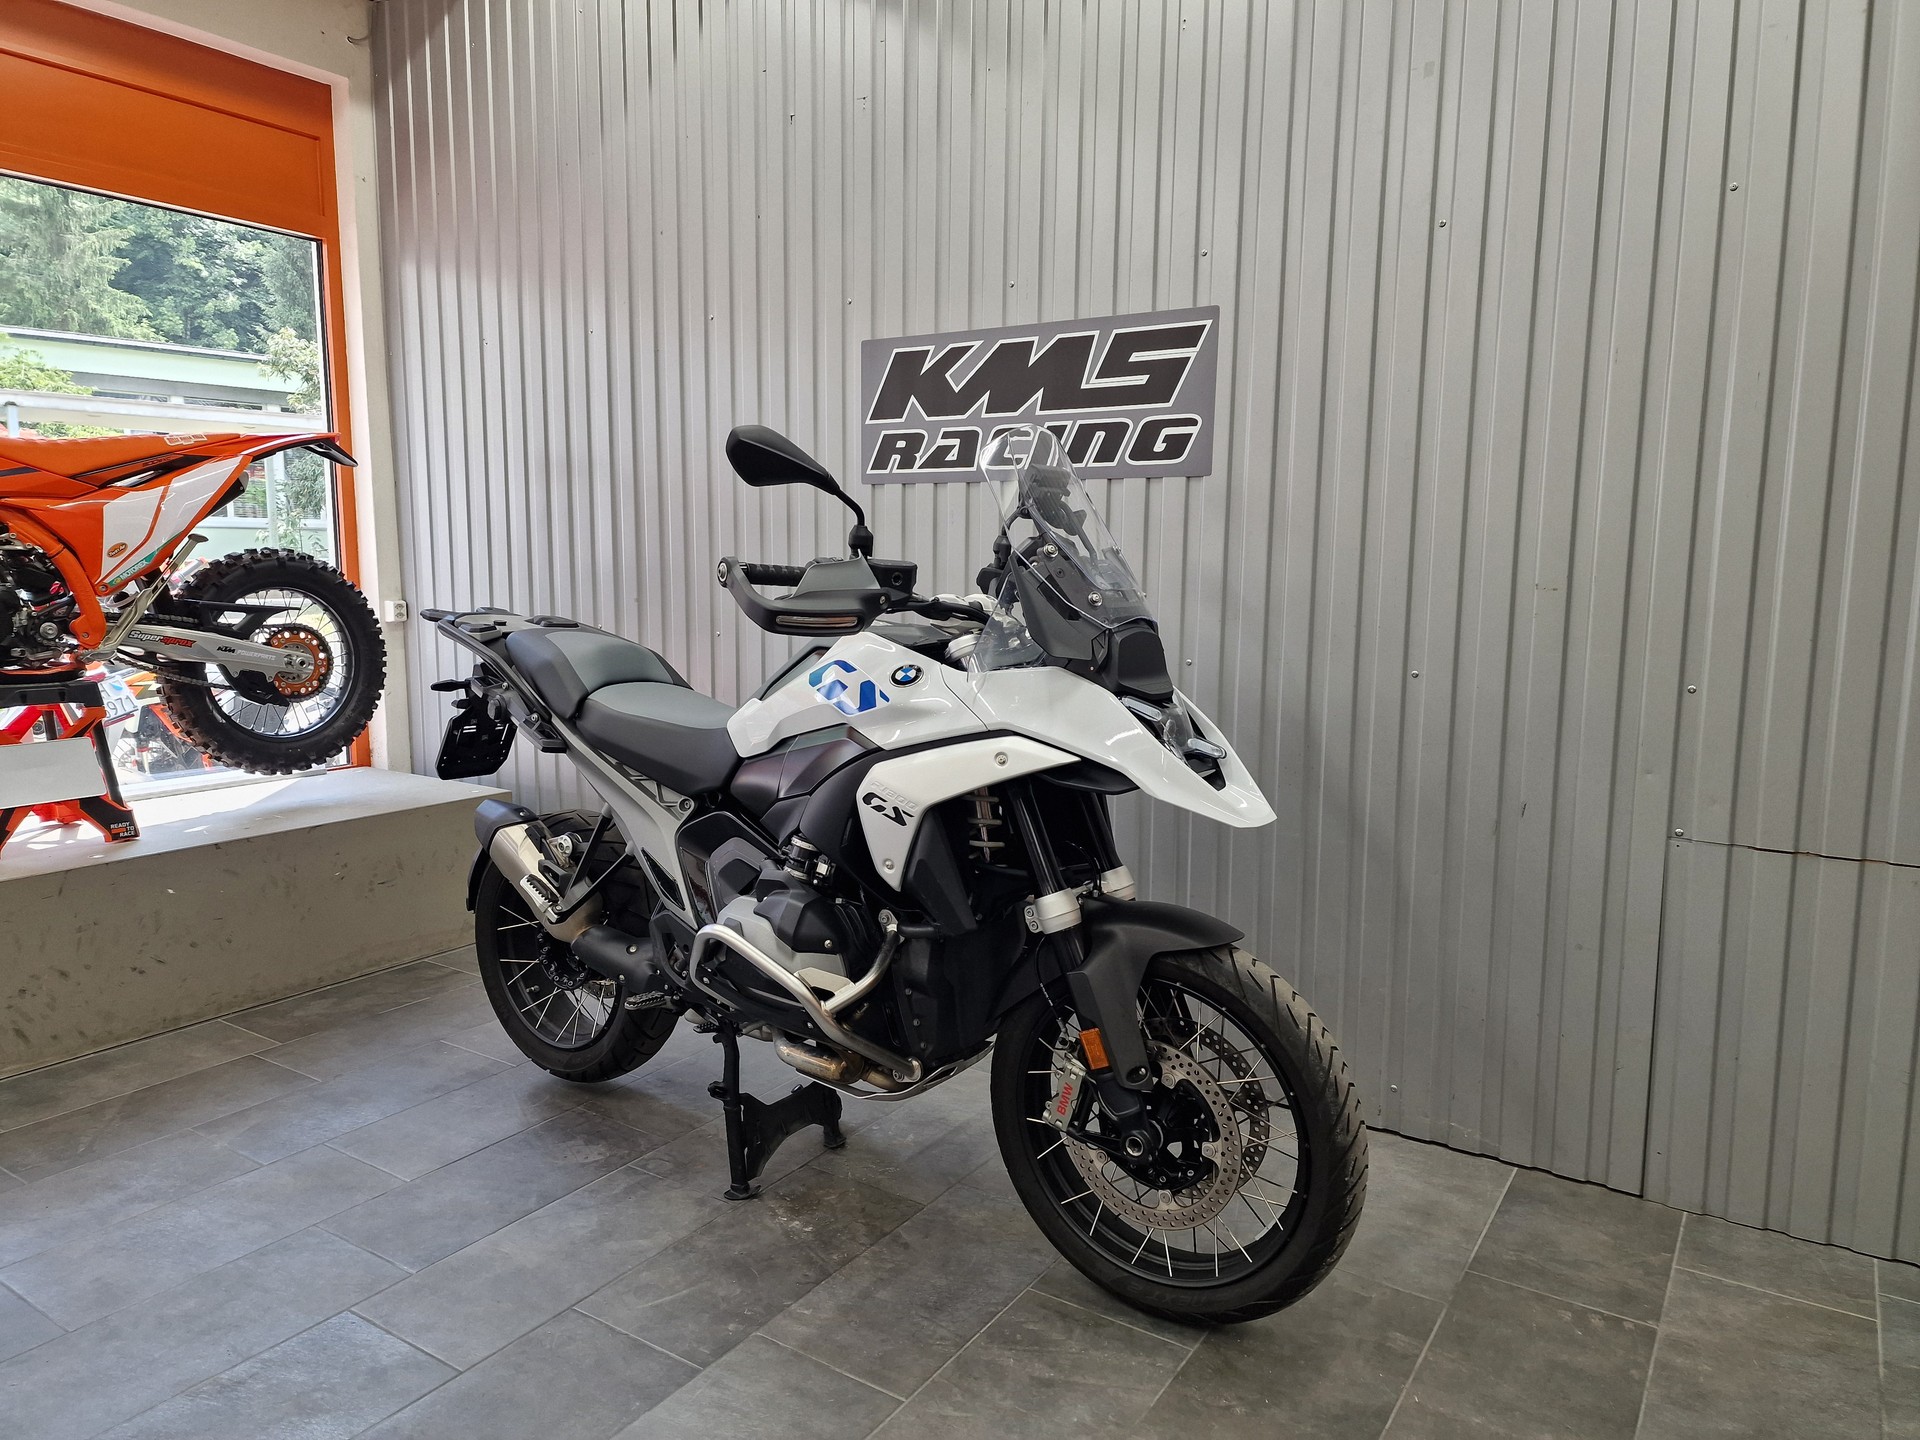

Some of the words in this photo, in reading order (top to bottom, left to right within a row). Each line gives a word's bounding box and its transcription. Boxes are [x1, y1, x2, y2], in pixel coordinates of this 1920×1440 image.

[865, 319, 1213, 424] KMS
[866, 413, 1203, 475] RACING
[120, 559, 147, 579] MOTOREX
[128, 629, 197, 648] Supersprox
[217, 645, 235, 654] KTM
[862, 791, 915, 827] GS
[110, 821, 130, 829] READY
[119, 830, 135, 838] RACE
[1056, 1081, 1073, 1116] BMW
